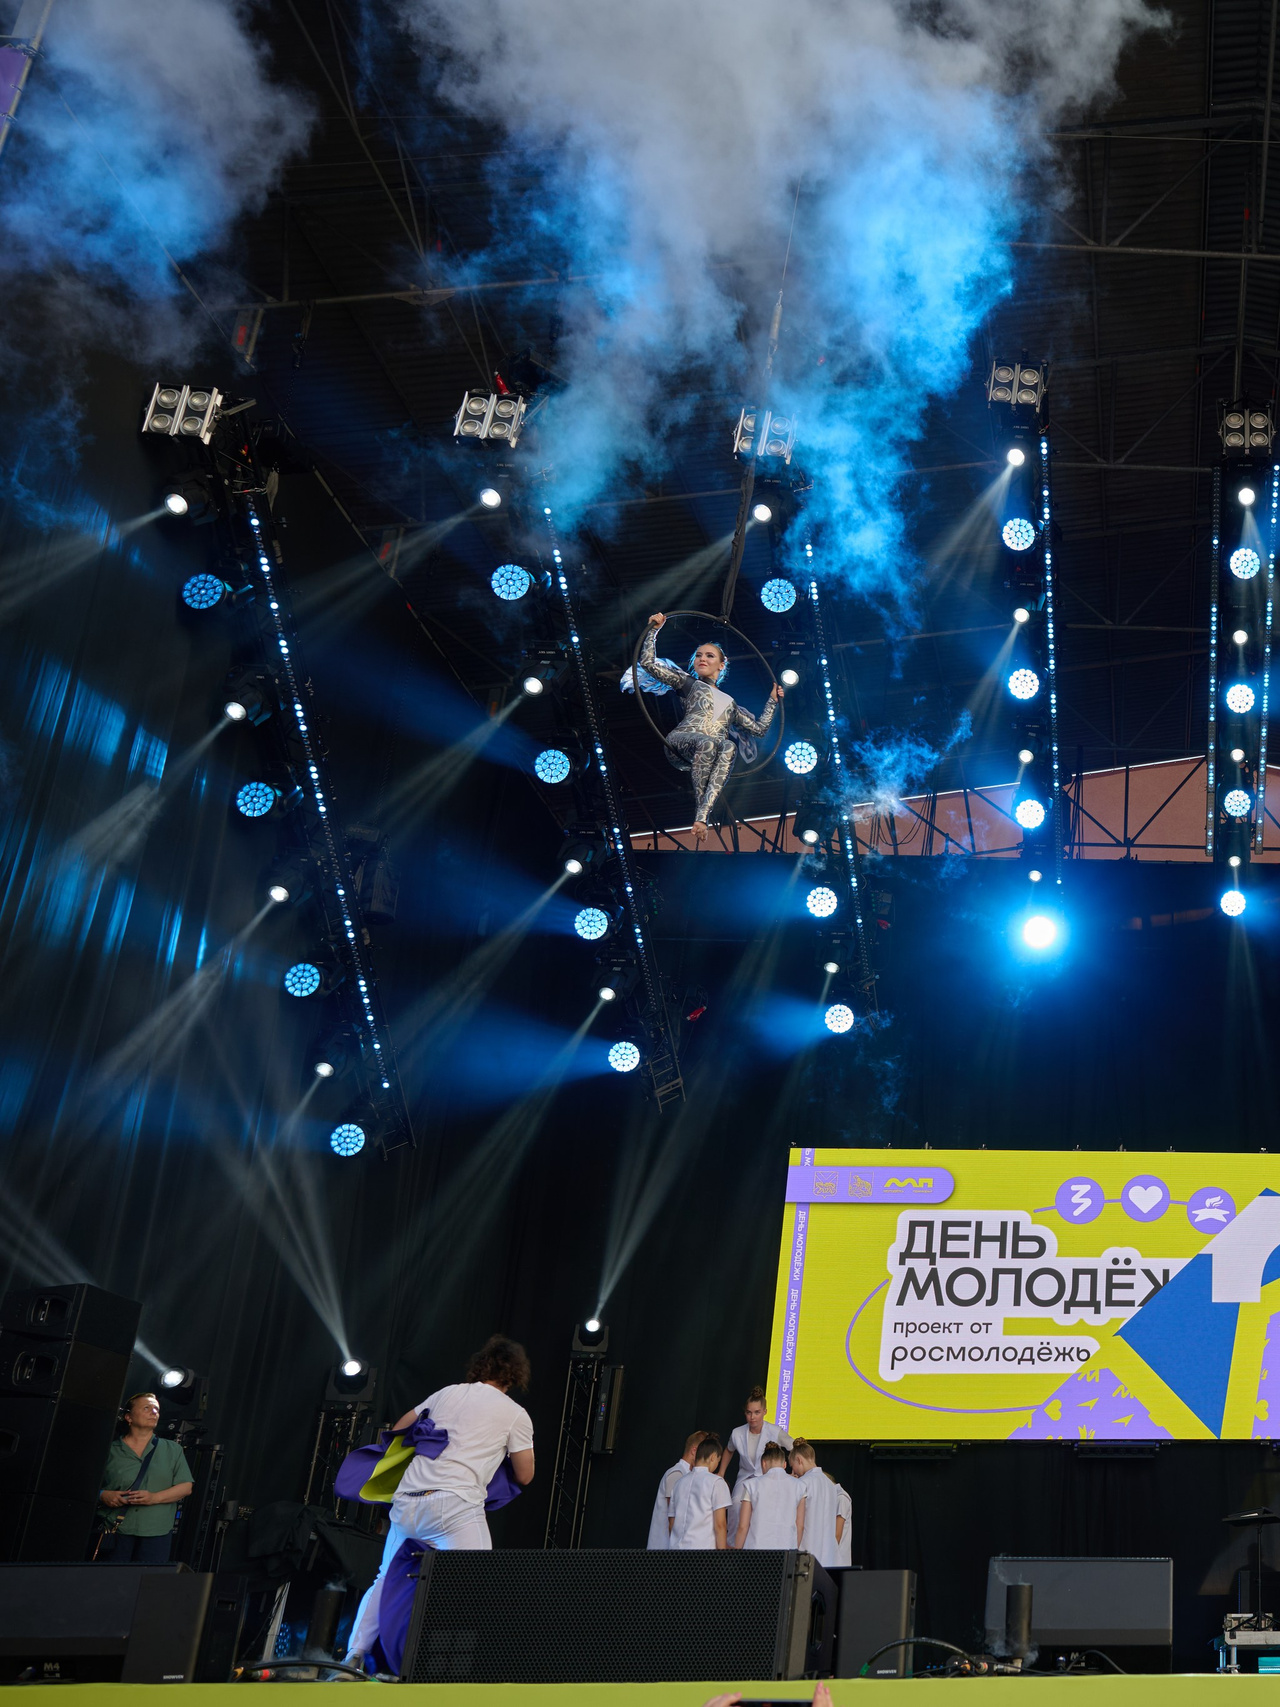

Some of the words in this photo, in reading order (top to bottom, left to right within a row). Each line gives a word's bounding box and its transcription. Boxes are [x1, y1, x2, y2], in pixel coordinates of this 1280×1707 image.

[797, 1210, 806, 1232] ДЕНЬ
[793, 1233, 804, 1281] МОЛОДЁЖИ
[898, 1220, 1047, 1266] ДЕНЬ
[790, 1288, 799, 1311] ДЕНЬ
[895, 1257, 1170, 1315] МОЛОДЁ
[785, 1311, 796, 1361] МОЛОДЁЖИ
[893, 1321, 964, 1338] проект
[969, 1321, 993, 1334] от
[890, 1341, 1091, 1371] росмолодёжь
[782, 1369, 791, 1392] ДЕНЬ
[778, 1393, 789, 1430] МОЛОДЁ
